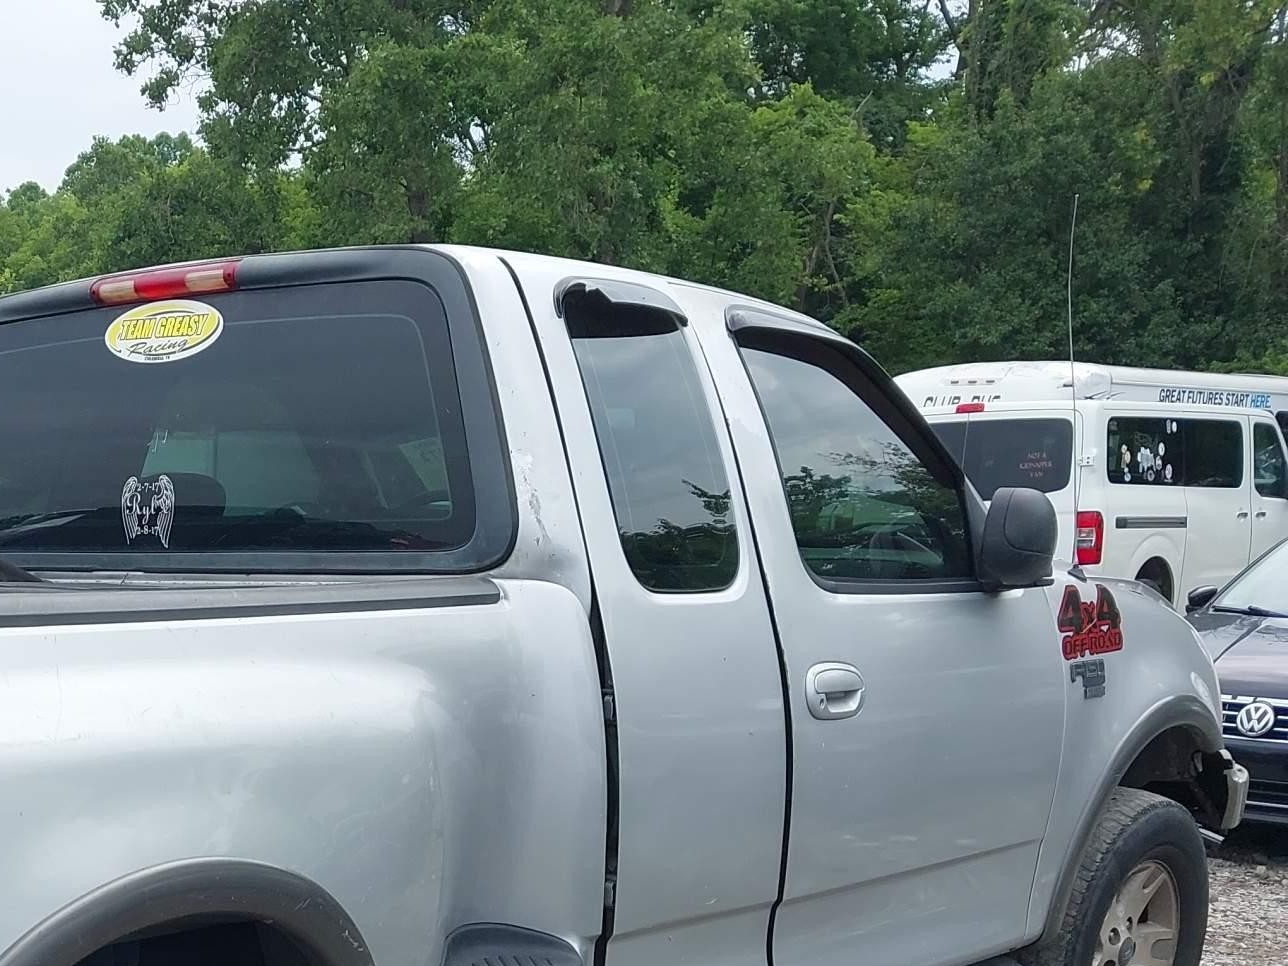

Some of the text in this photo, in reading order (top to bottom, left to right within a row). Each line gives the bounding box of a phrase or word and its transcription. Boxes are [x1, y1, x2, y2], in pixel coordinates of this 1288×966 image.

[119, 313, 209, 341] TEAM GREASY
[126, 340, 188, 357] Racing
[1159, 388, 1187, 403] GREAT
[1187, 390, 1224, 406] FUTURES
[1224, 393, 1250, 408] START
